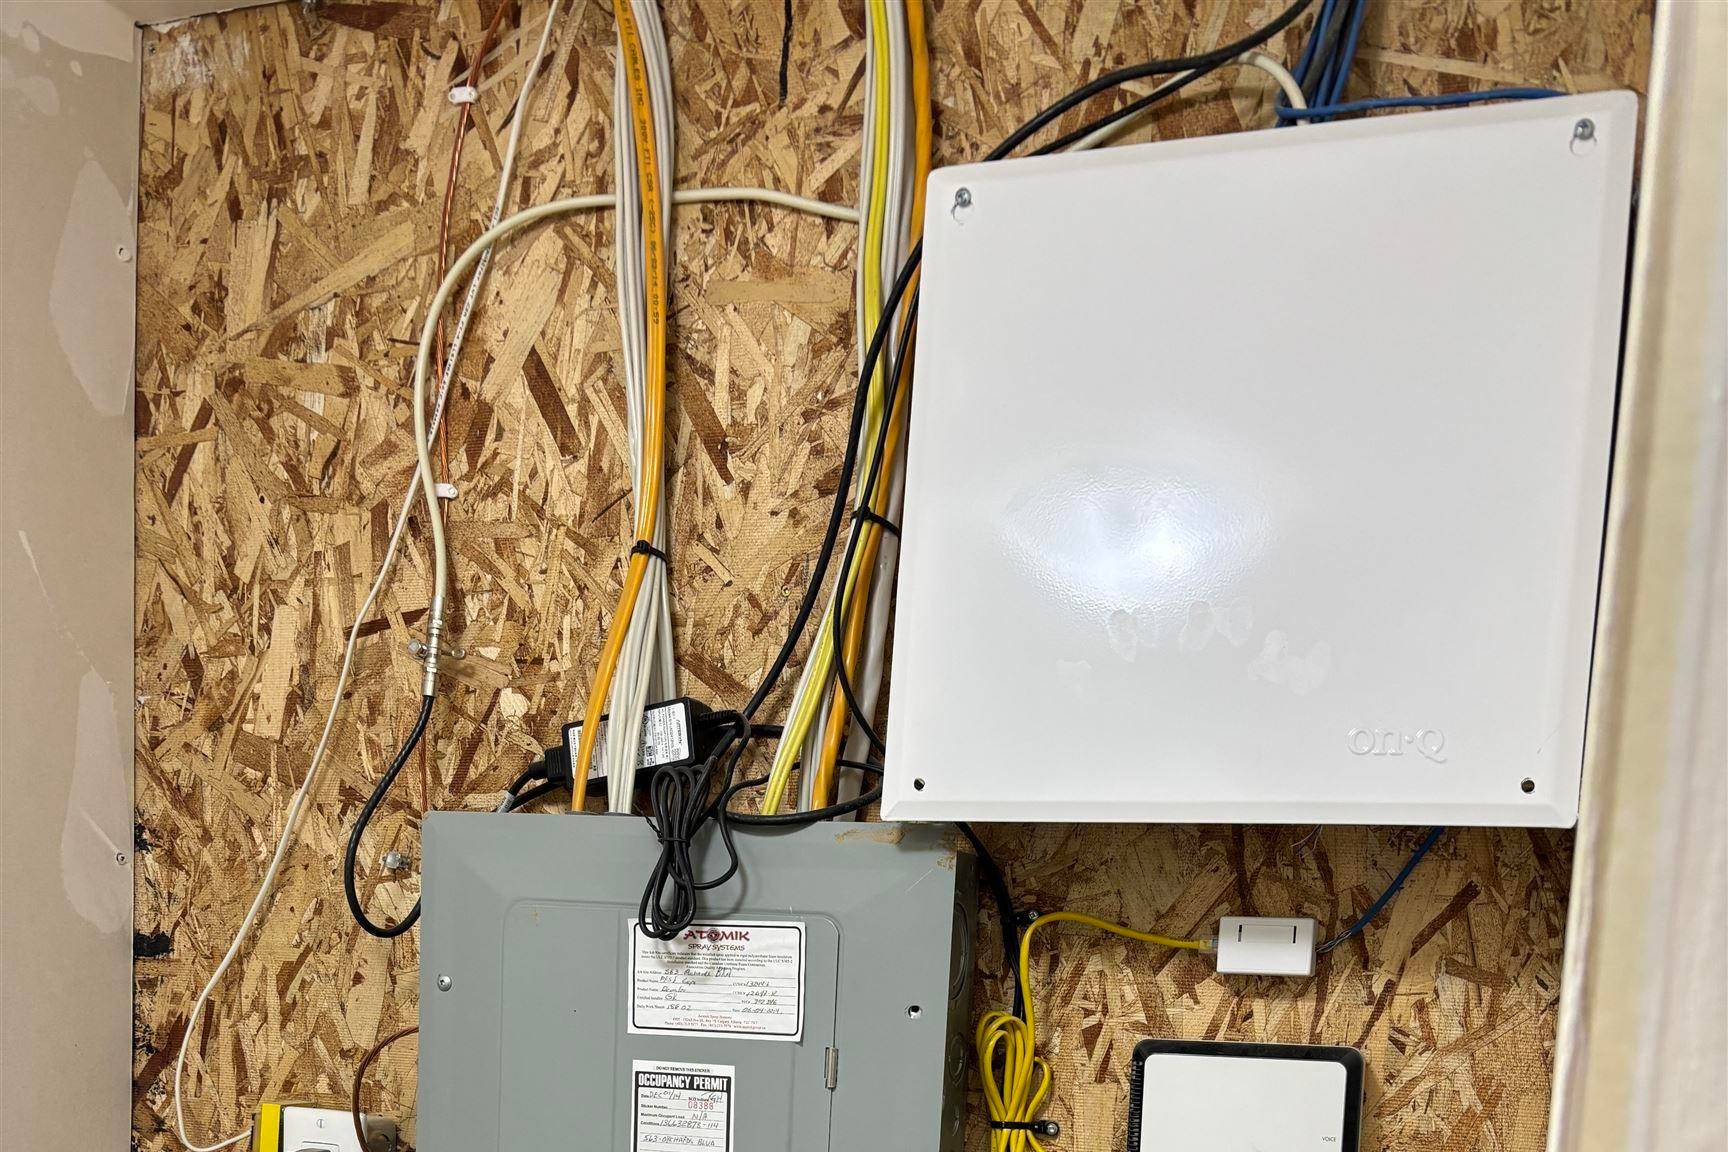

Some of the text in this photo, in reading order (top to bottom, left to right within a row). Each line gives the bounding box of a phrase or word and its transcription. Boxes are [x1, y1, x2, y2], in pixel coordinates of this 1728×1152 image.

[683, 928, 750, 943] ATOMIK
[638, 1073, 728, 1091] OCCUPANCY PERMIT
